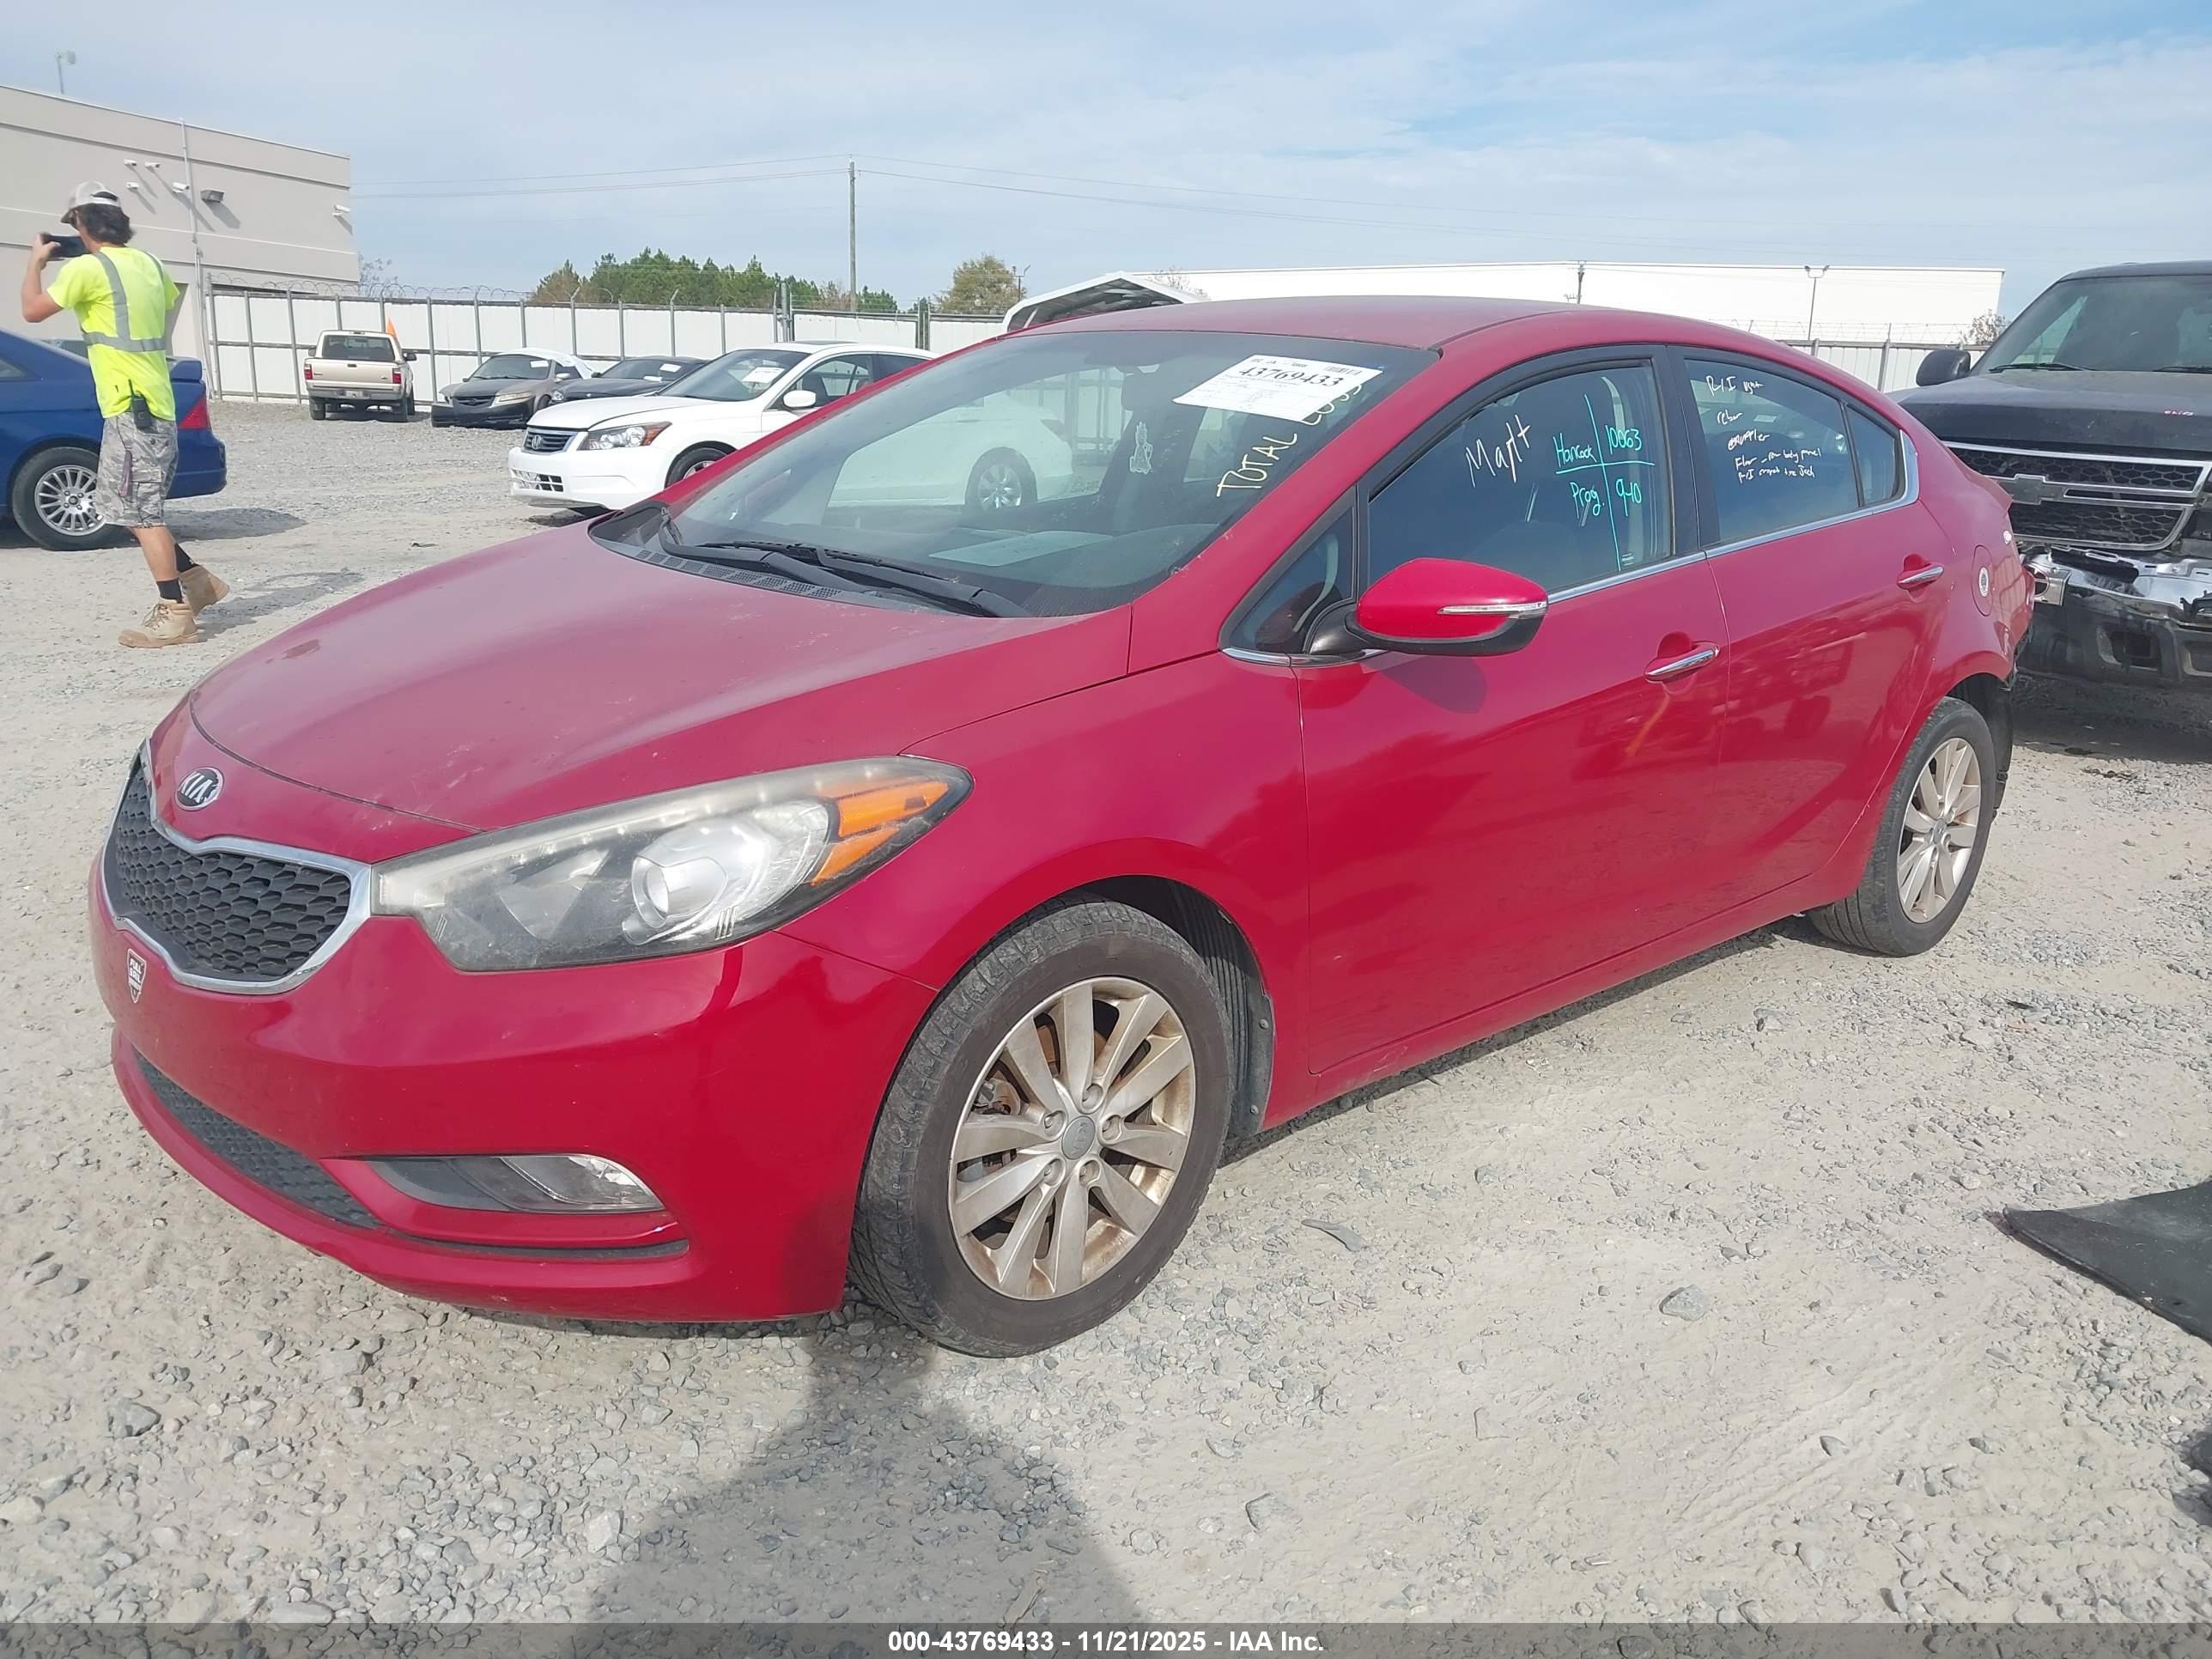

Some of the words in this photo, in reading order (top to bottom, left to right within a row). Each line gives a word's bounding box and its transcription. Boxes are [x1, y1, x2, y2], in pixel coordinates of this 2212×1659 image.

[1238, 366, 1345, 386] 43769433
[1216, 433, 1298, 498] TOTAL
[1553, 432, 1597, 468] Hancock
[1605, 424, 1643, 456] 10063
